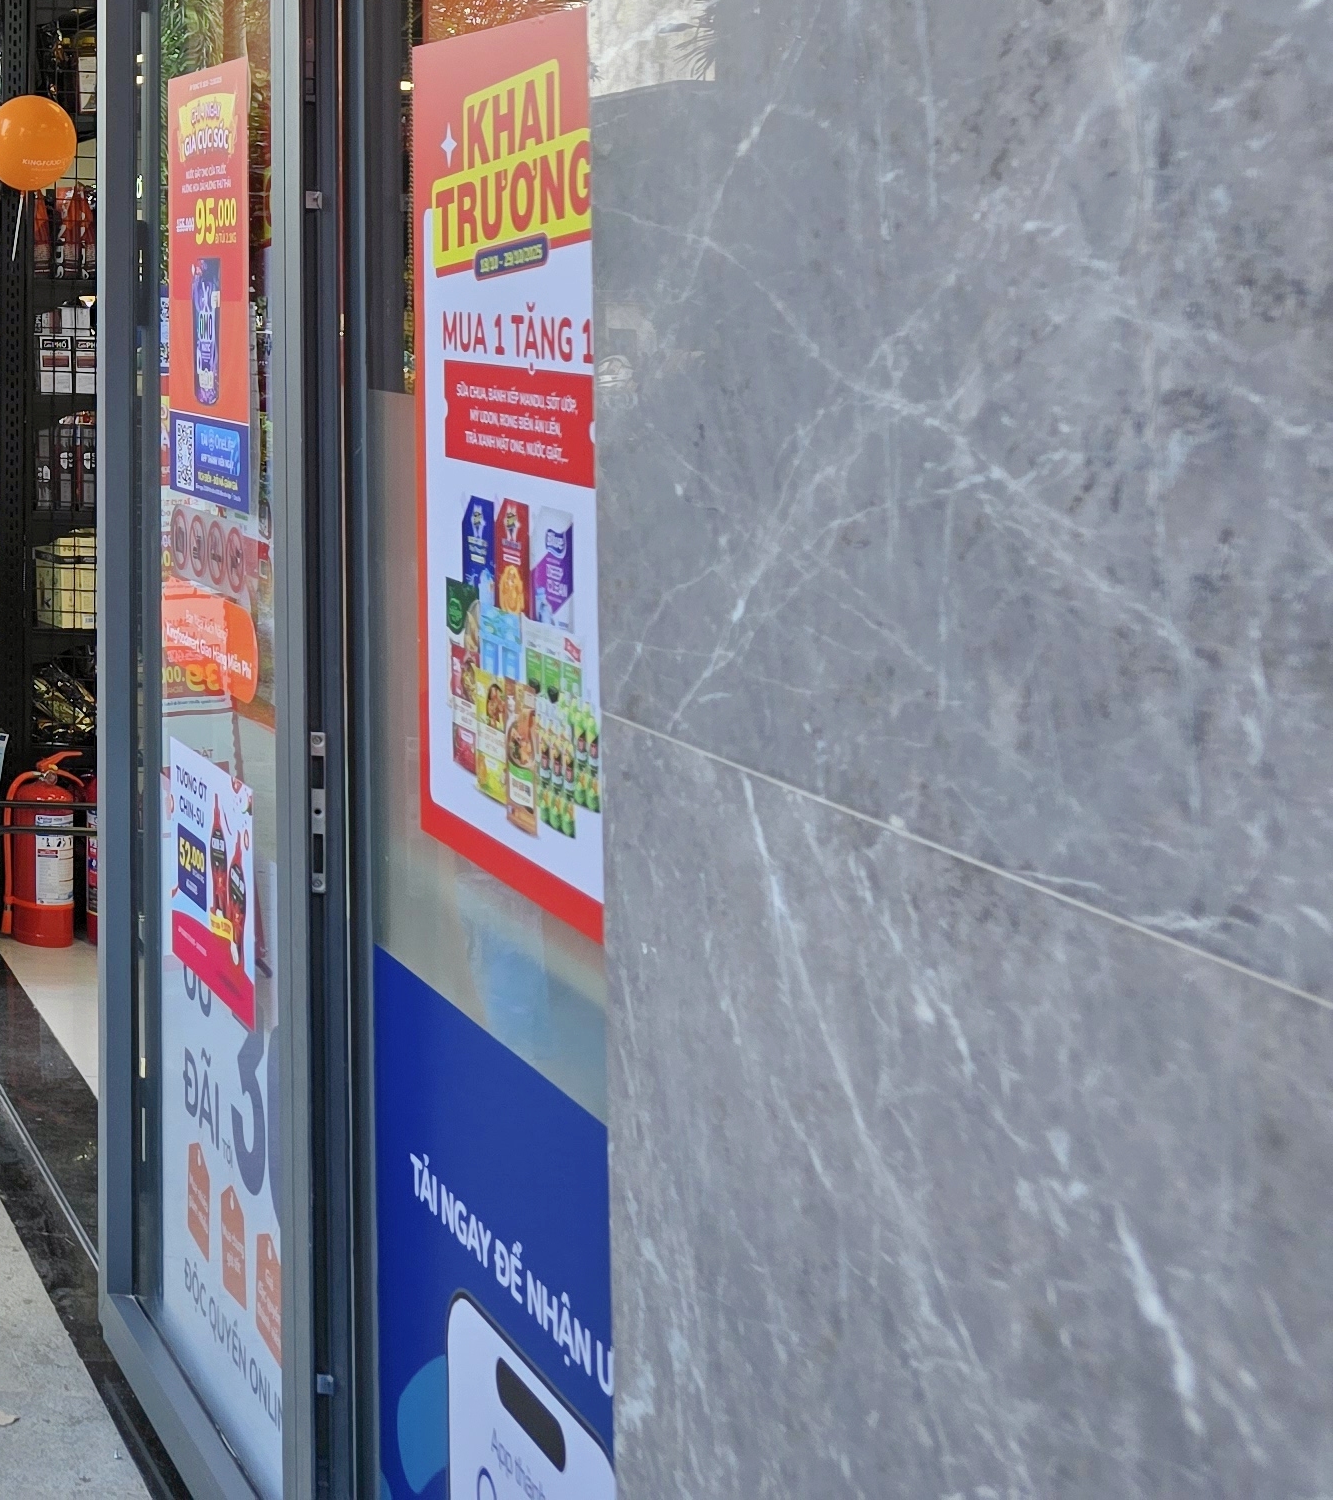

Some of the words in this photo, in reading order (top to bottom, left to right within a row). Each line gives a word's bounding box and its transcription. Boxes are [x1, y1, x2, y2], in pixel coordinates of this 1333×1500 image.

[213, 120, 229, 149] SỐC
[466, 71, 558, 171] KHAI
[195, 197, 237, 245] 95.000
[434, 140, 591, 252] TRƯƠNG
[198, 312, 213, 341] OMO
[442, 310, 488, 355] MUA
[494, 313, 506, 356] 1
[511, 301, 573, 375] TẶNG
[582, 318, 594, 364] 1
[175, 764, 198, 795] TƯƠNG
[198, 776, 208, 802] ỚT
[179, 795, 205, 829] CHIN-SU
[179, 837, 205, 873] 52.000
[183, 1047, 221, 1152] ĐÃI
[409, 1152, 439, 1216] TẢI
[441, 1191, 492, 1269] NGAY
[494, 1240, 523, 1305] ĐỂ
[527, 1270, 593, 1378] NHẬN
[184, 1257, 207, 1319] ĐỘC
[208, 1296, 247, 1380] QUYỀN
[249, 1355, 283, 1434] ONLIN
